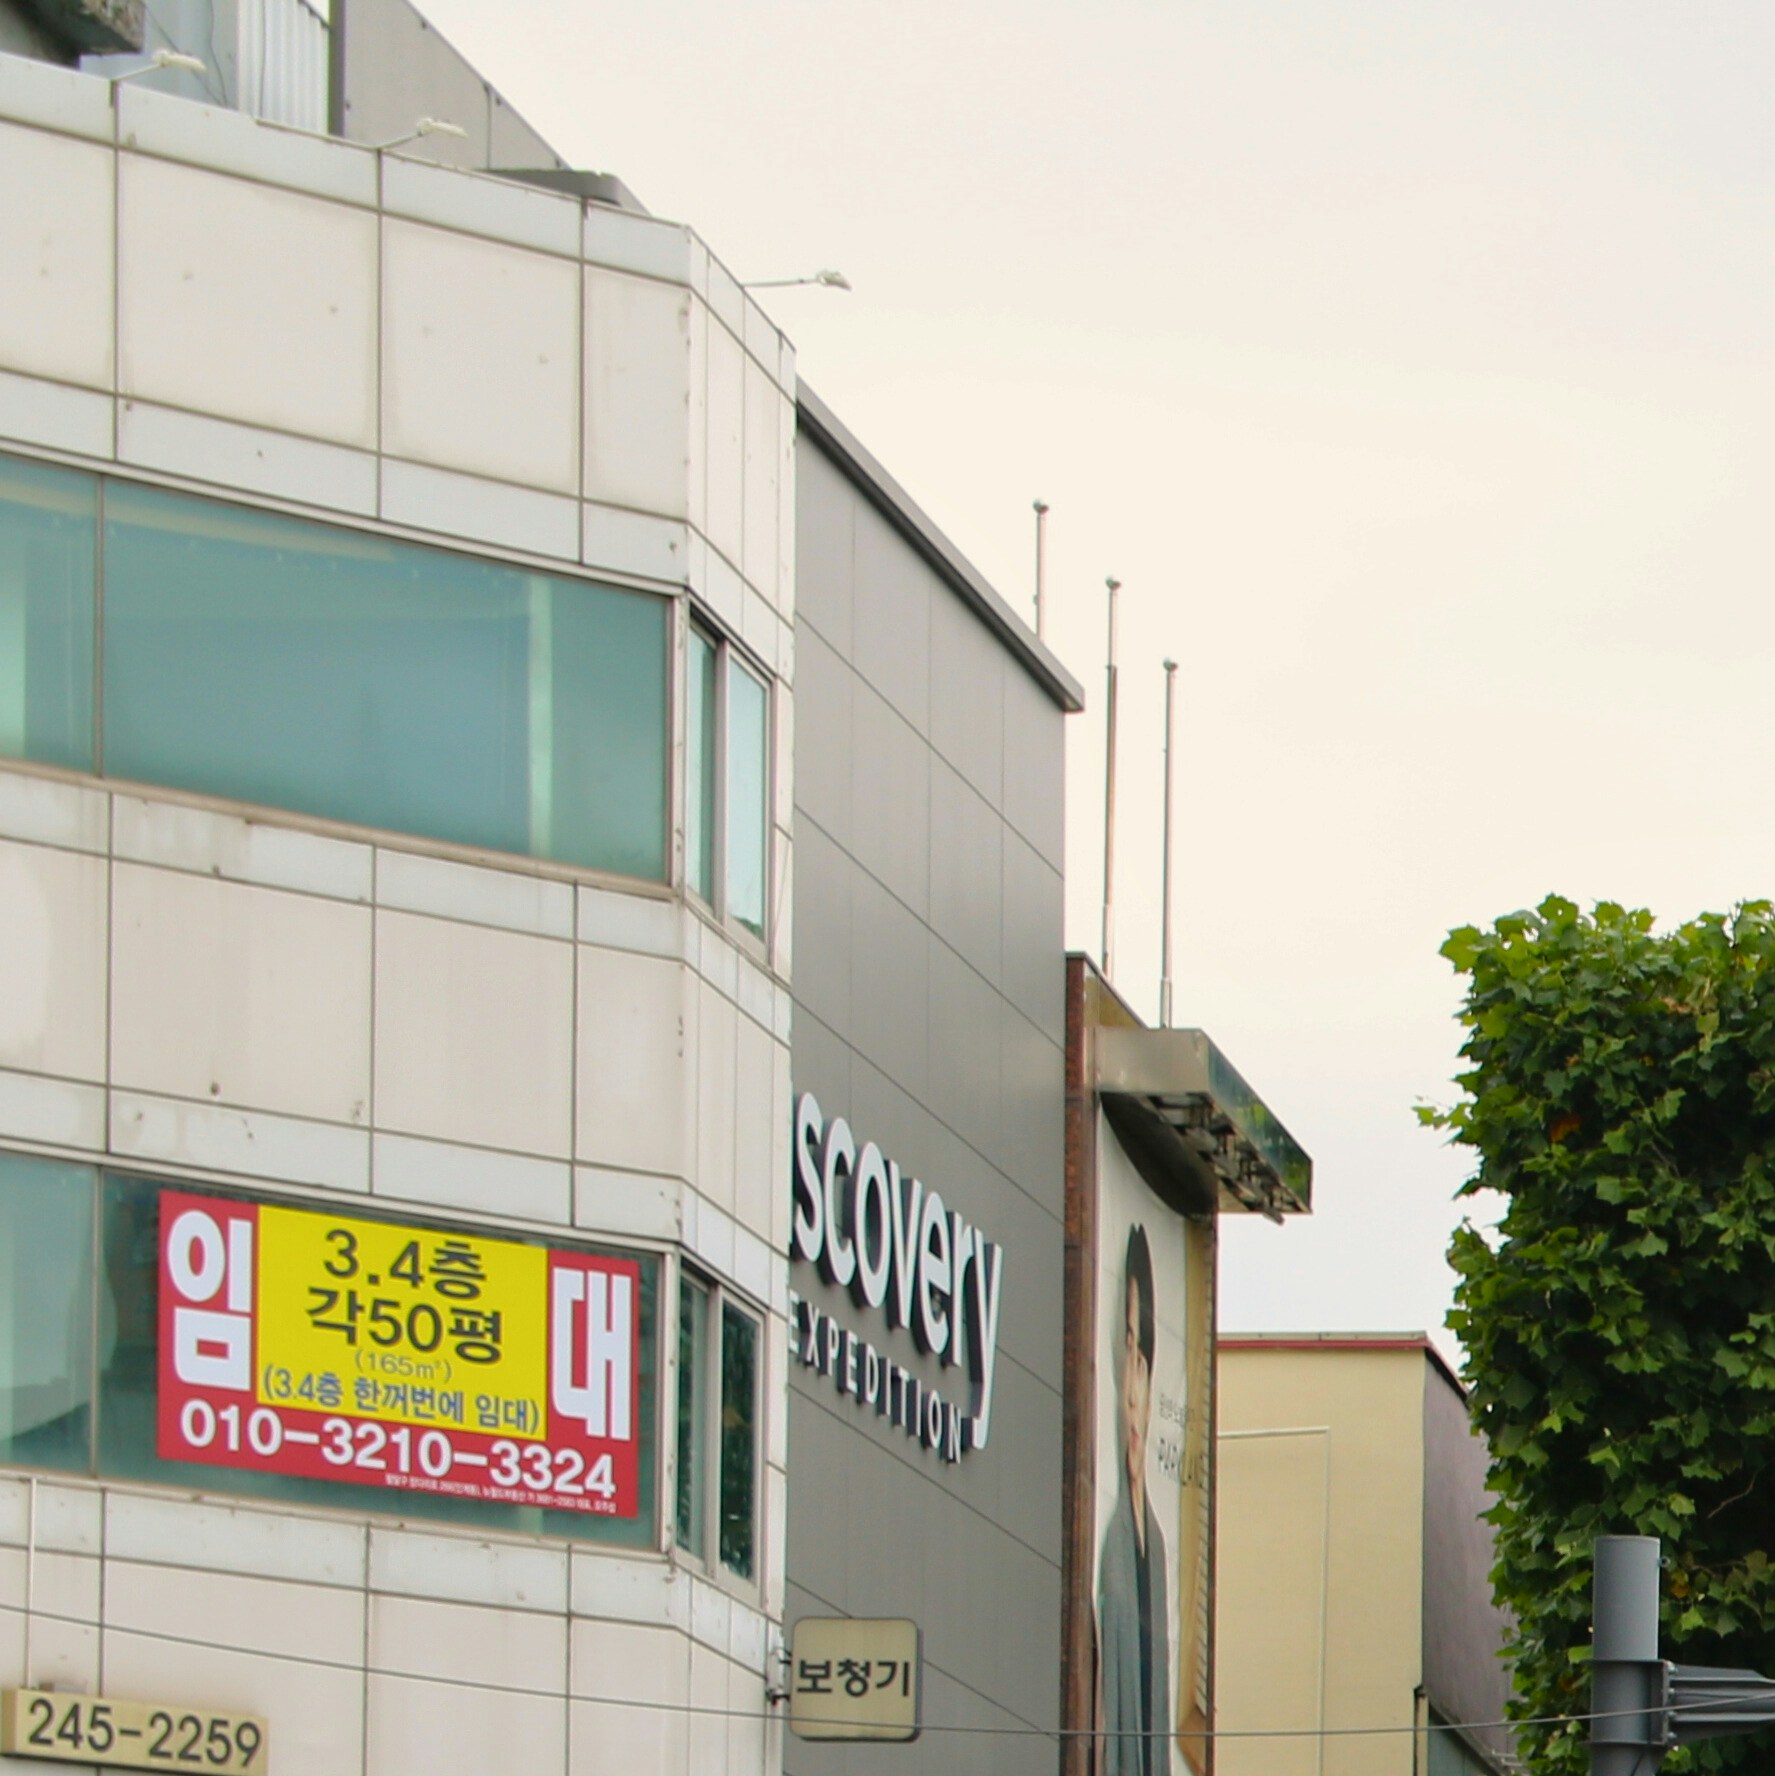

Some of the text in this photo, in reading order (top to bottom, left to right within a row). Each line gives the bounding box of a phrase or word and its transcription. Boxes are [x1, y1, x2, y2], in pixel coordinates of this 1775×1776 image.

[322, 1227, 486, 1302] 3.4층
[166, 1208, 631, 1442] 임 대
[306, 1285, 502, 1367] 각50평
[355, 1377, 463, 1423] 한꺼번에
[475, 1394, 540, 1434] 임대)
[788, 1289, 961, 1464] EXPEDITION
[180, 1400, 617, 1500] 010-3210-3324
[798, 1657, 909, 1698] 보청기
[29, 1699, 261, 1767] 245-2259
